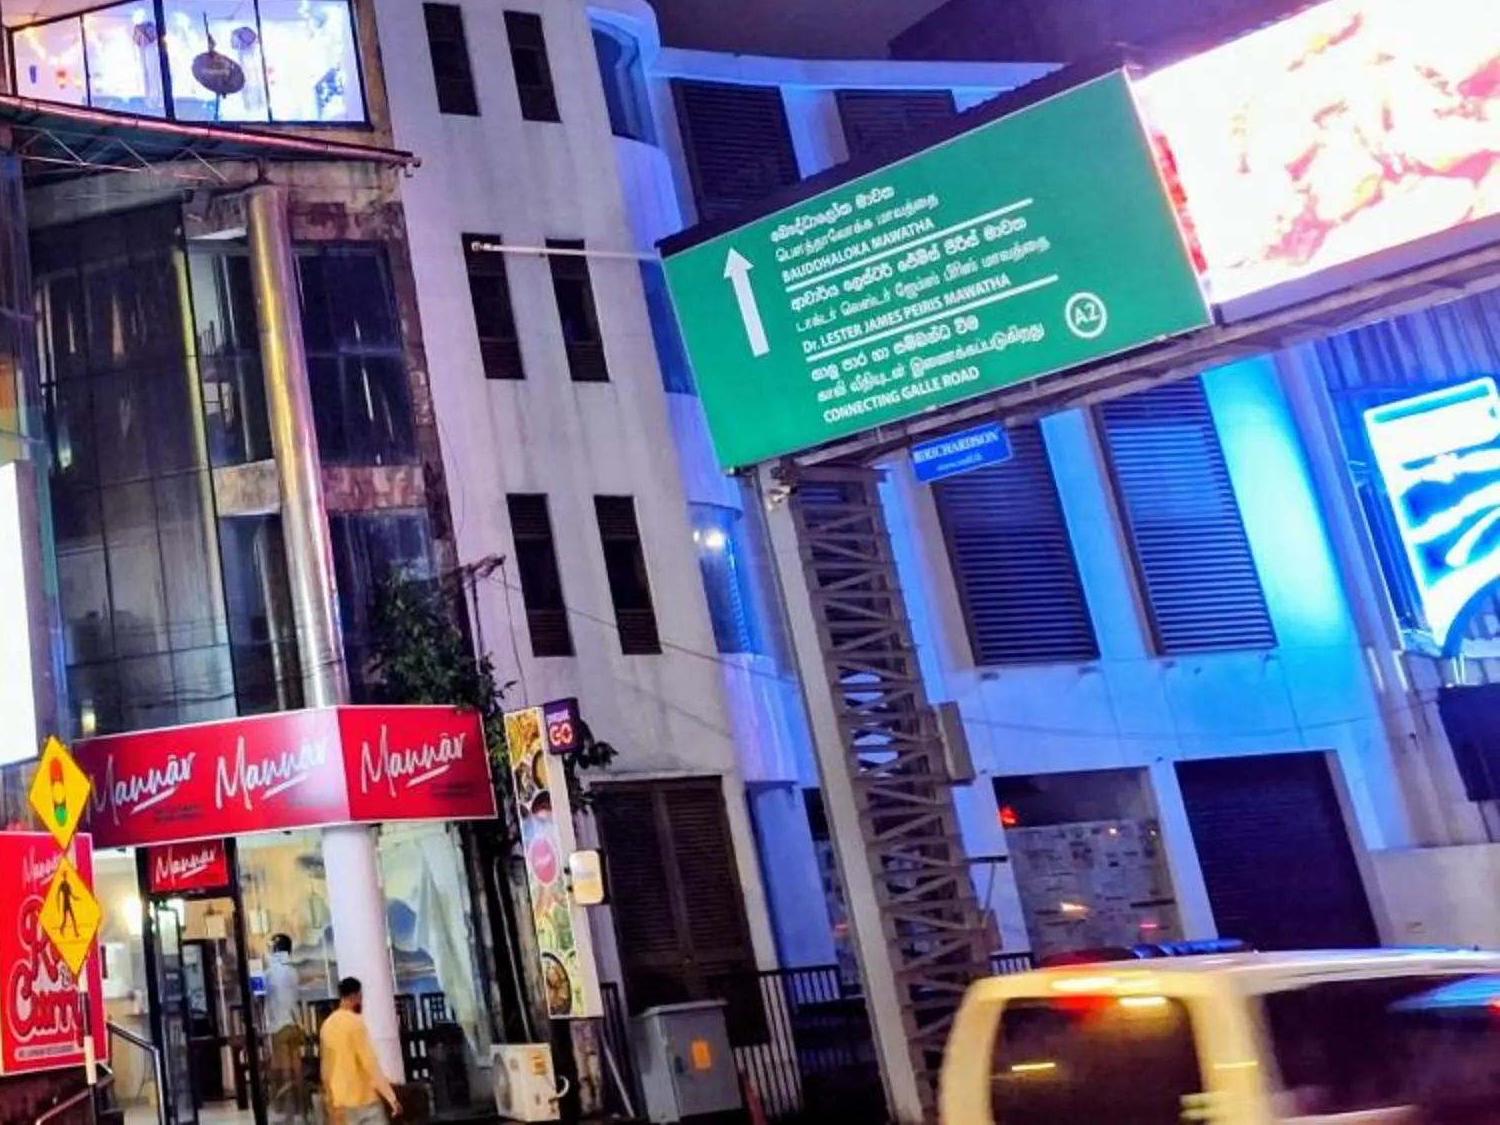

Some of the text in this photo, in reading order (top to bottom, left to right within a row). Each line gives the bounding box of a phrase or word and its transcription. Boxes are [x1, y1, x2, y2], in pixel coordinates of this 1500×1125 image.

[782, 218, 934, 282] BAUDDHALOKA MAWATHA
[803, 274, 1011, 353] Dr. LESTER JAMES PEIRIS MAWATHA
[1070, 301, 1102, 328] A2
[824, 366, 979, 423] CONNECTING GALLE ROAD
